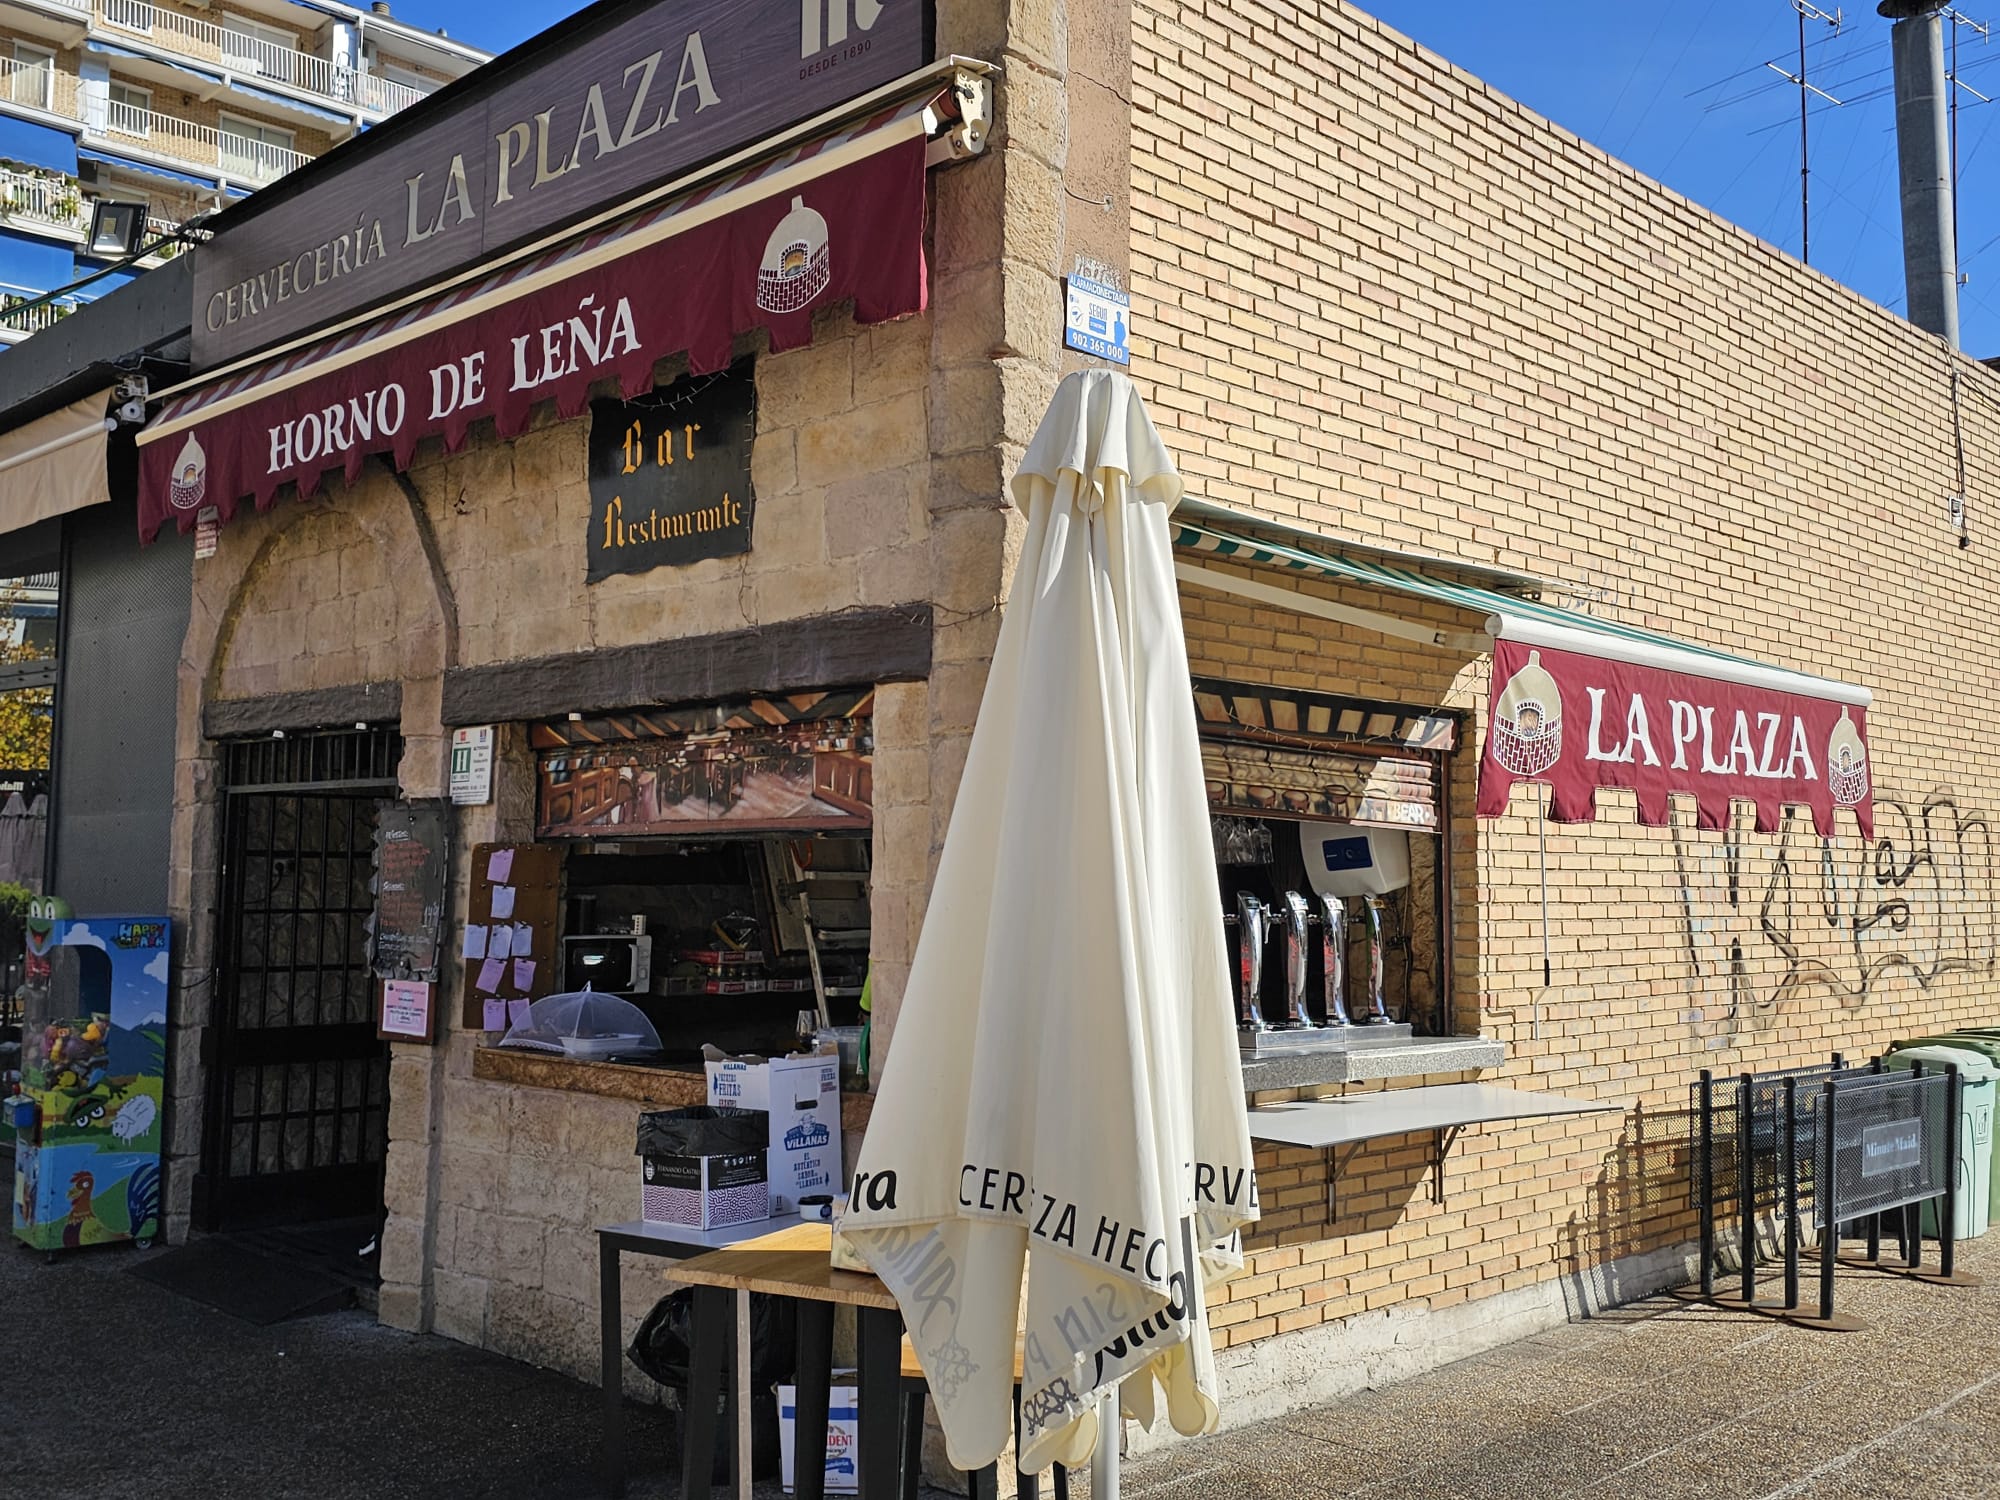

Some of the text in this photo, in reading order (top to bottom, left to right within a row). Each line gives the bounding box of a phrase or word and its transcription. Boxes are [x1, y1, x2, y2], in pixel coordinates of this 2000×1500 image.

[799, 39, 872, 81] DESDE 1890
[205, 211, 387, 332] CERVECERÍA
[402, 153, 476, 249] LA
[492, 30, 721, 207] PLAZA
[1072, 332, 1123, 359] 902 365 000
[265, 292, 642, 475] HORNO DE LEÑA
[621, 418, 702, 475] Bar
[602, 492, 742, 549] Restaurante
[1585, 686, 1818, 780] LA PLAZA
[119, 923, 166, 937] HAPPY
[718, 1083, 741, 1097] FRITAS
[1865, 1132, 1917, 1158] Minute Maid
[1091, 1215, 1168, 1285] HEC
[827, 1434, 853, 1447] DENT
